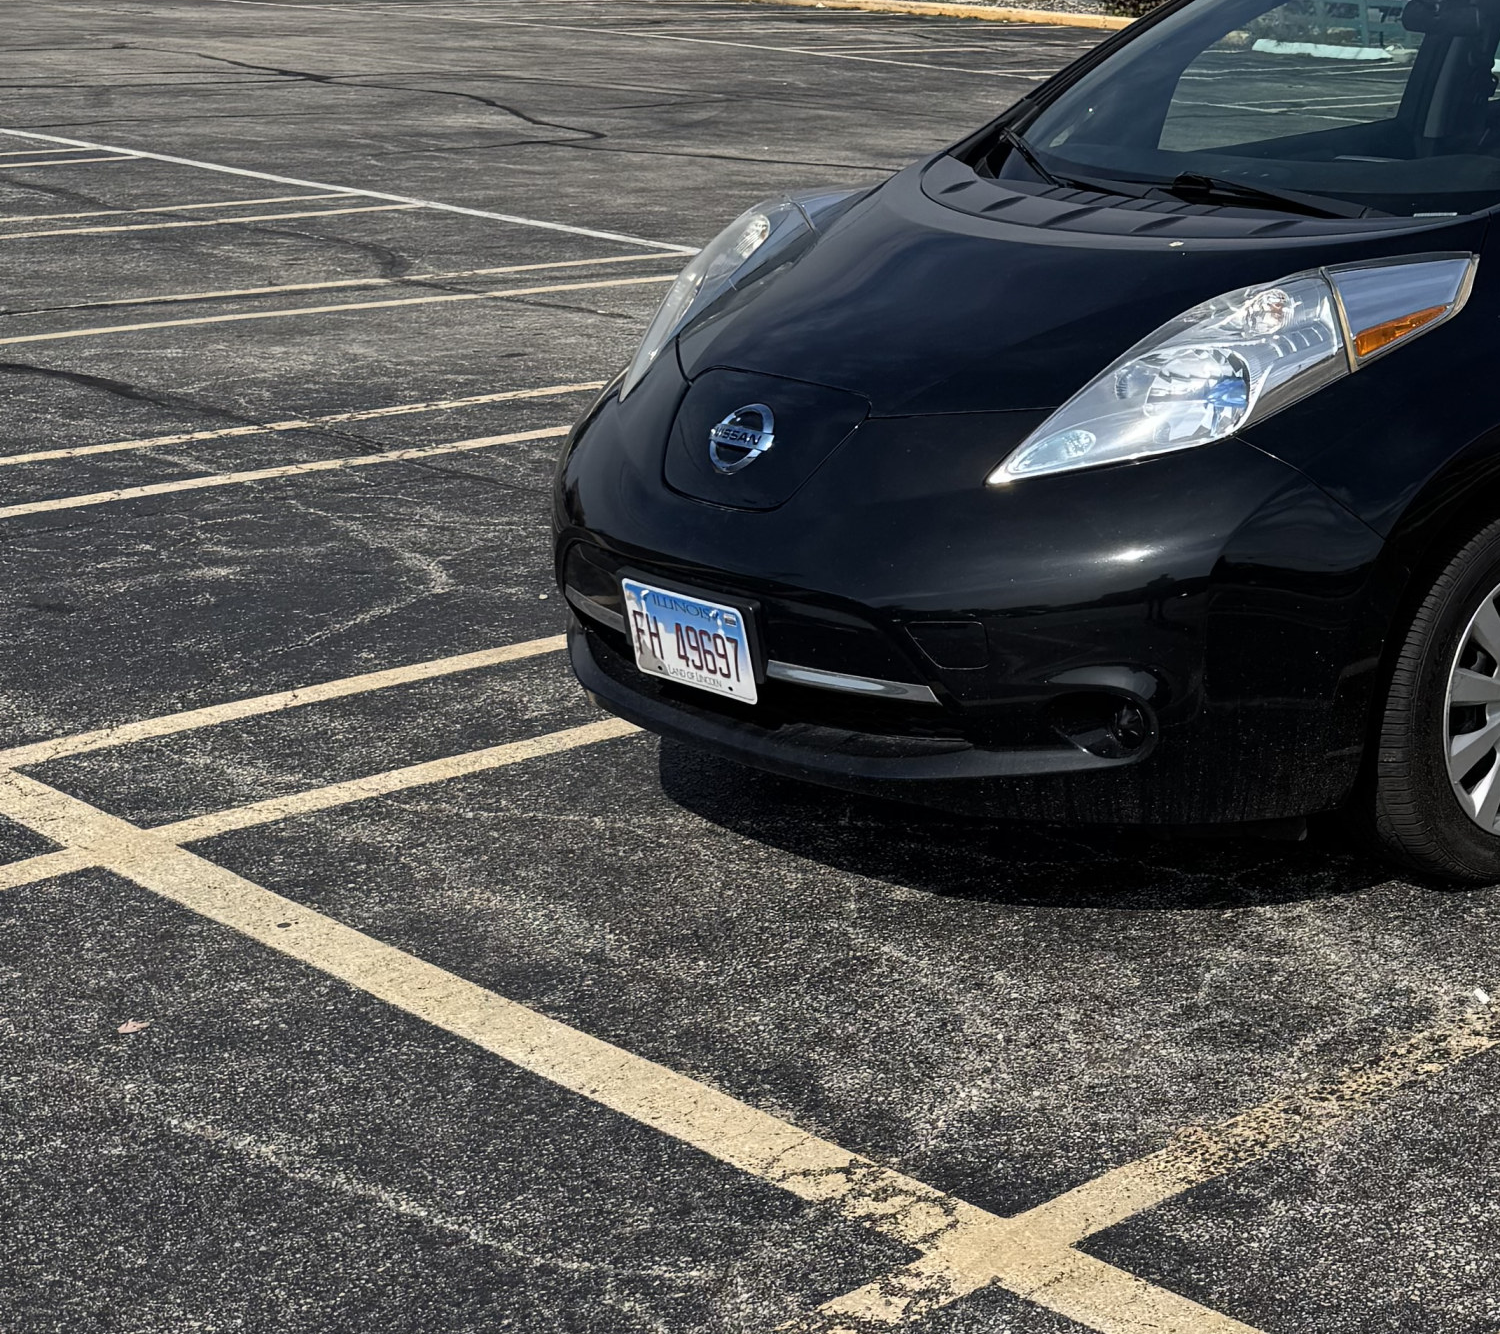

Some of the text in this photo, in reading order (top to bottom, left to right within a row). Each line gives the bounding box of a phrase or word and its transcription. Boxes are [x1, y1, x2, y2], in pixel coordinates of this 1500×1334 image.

[713, 426, 763, 446] NISSAN
[651, 593, 713, 622] ILLINOIS
[632, 609, 741, 683] FH 49697
